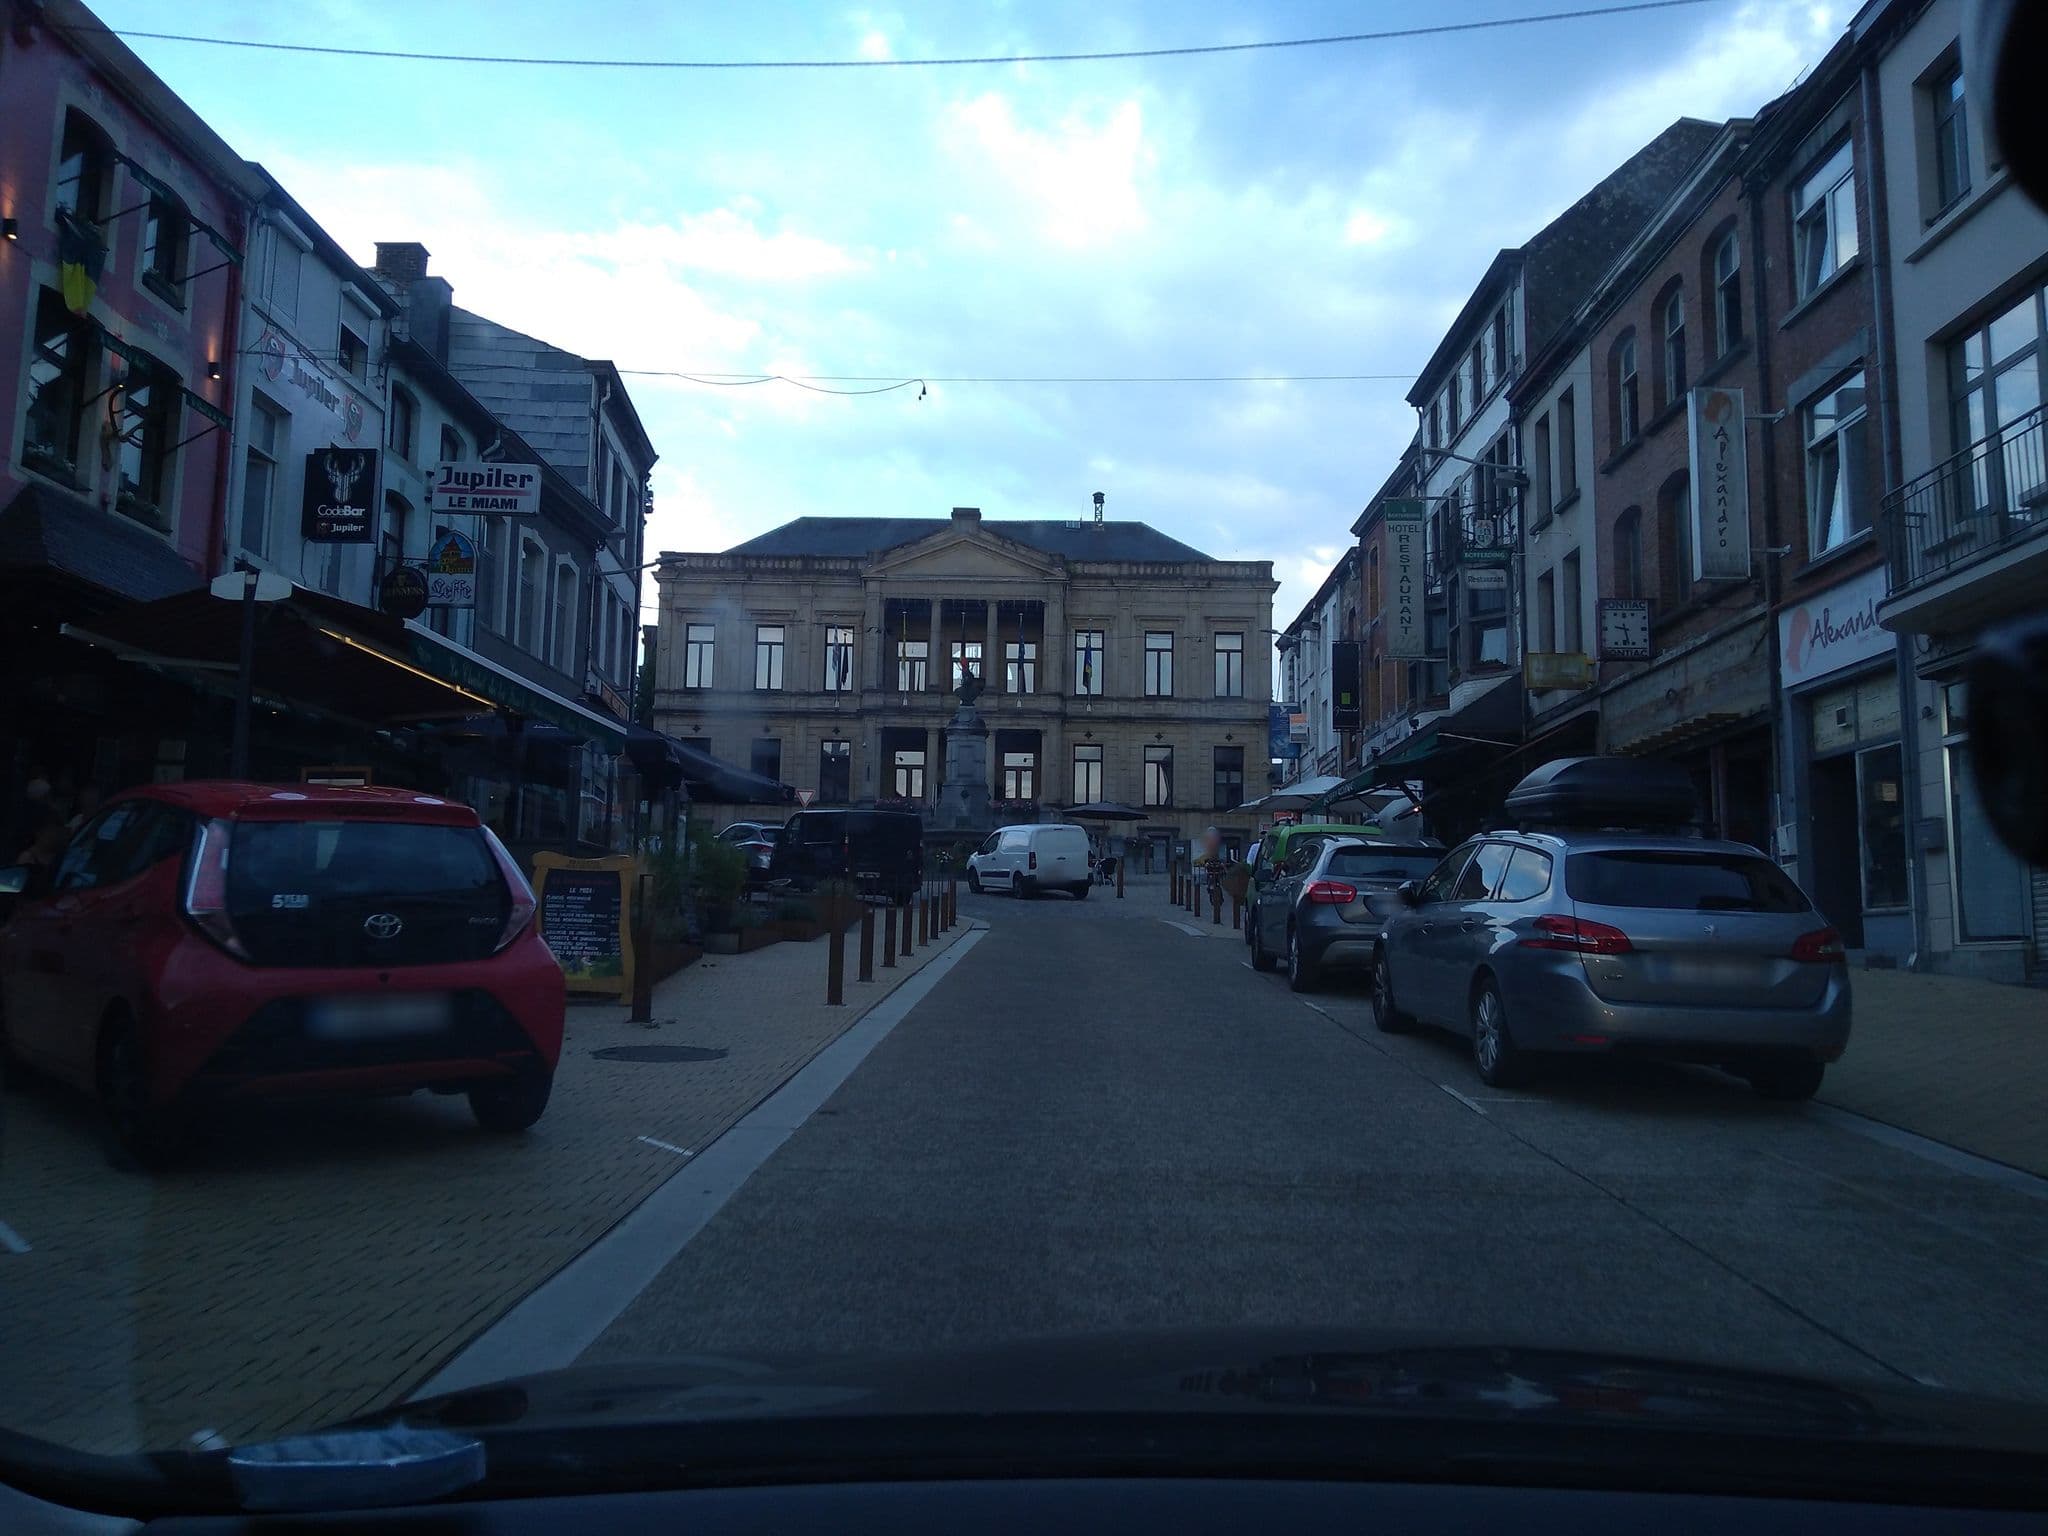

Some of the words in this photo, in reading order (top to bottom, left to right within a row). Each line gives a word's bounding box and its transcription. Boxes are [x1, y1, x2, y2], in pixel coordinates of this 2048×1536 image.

[288, 357, 340, 413] Jupiler
[439, 466, 534, 491] Jupiler
[1712, 426, 1729, 548] Alexandro
[448, 496, 467, 508] LE
[471, 497, 518, 510] MIAMI
[330, 523, 365, 533] Jupiler
[1388, 524, 1421, 533] HOTEL
[430, 577, 473, 601] Leffe
[1399, 534, 1412, 635] RESTAURANT
[1605, 599, 1647, 609] ONTIAC
[1810, 598, 1877, 648] Alexand
[1605, 649, 1648, 657] ONTIAC
